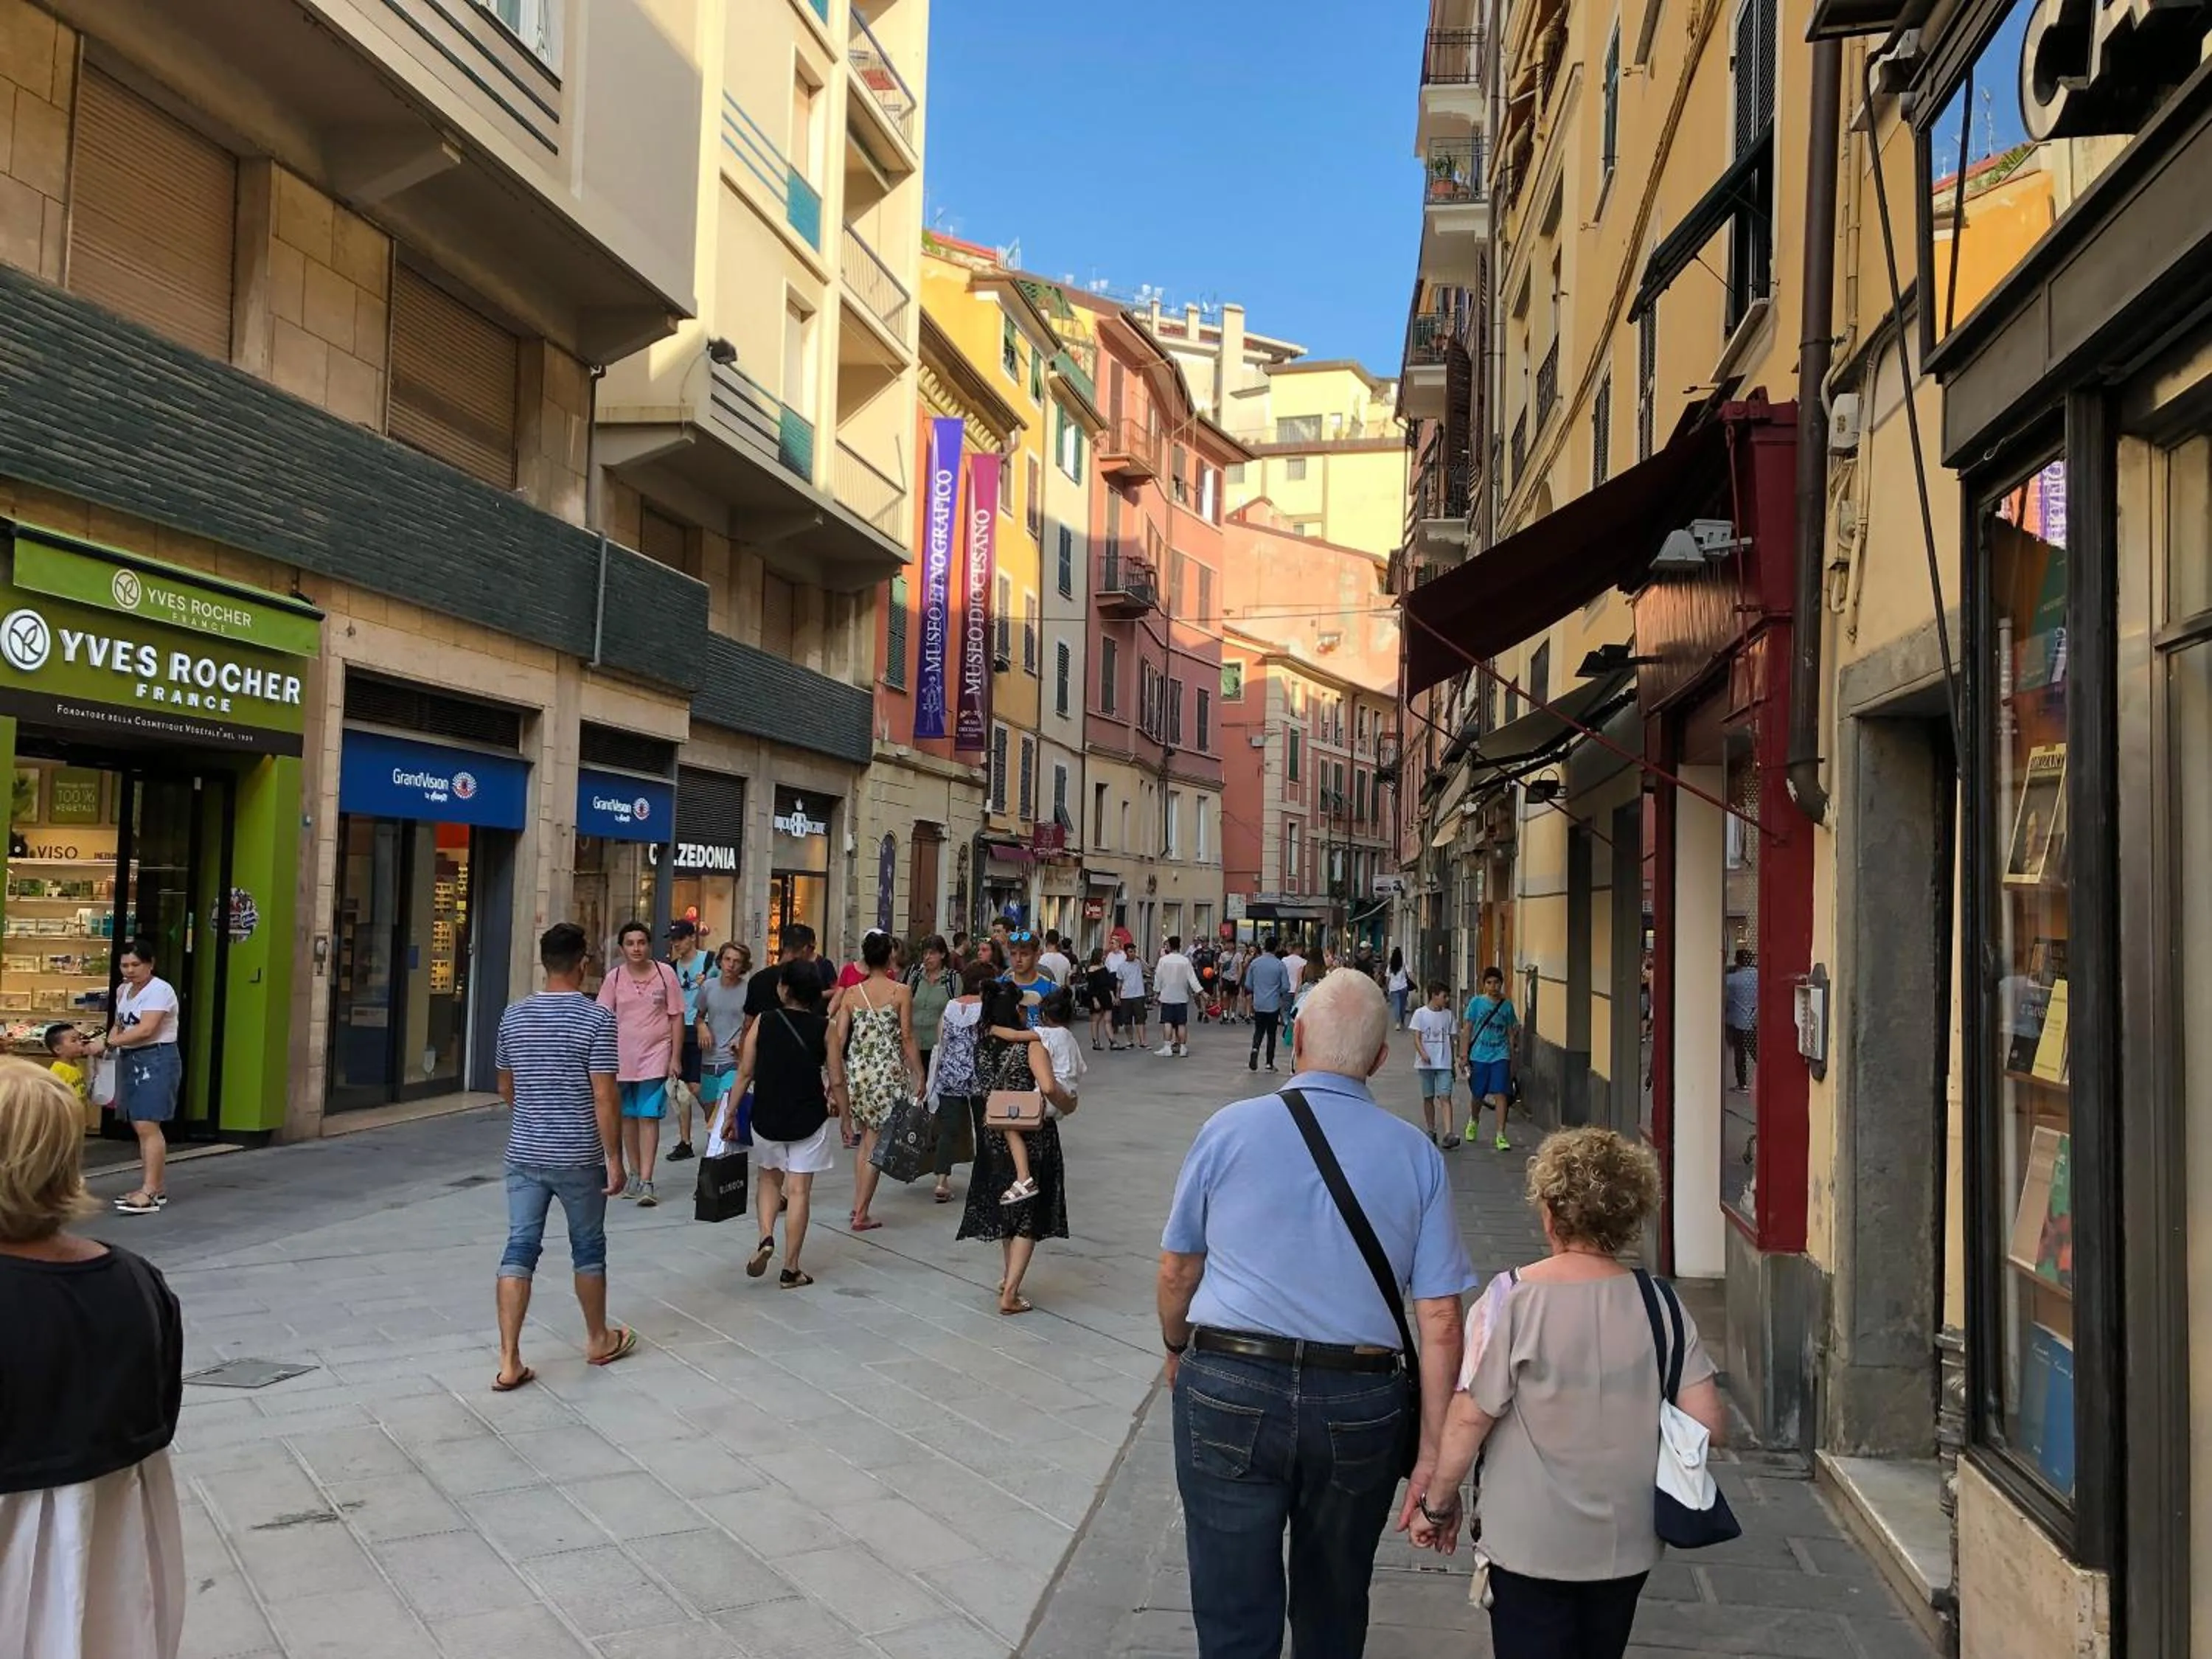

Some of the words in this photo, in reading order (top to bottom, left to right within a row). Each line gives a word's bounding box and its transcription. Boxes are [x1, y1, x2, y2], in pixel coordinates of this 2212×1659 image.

[928, 469, 953, 604] ETNOGRAFICO
[967, 509, 991, 625] DIOCESANO
[147, 587, 186, 613] YVES
[191, 599, 252, 628] ROCHER
[171, 613, 226, 633] FRANCE
[925, 606, 944, 673] MUSEO
[58, 629, 158, 678] YVES
[168, 651, 301, 705] ROCHER
[964, 626, 984, 696] MUSEO
[136, 684, 232, 713] FRANCE
[393, 768, 449, 790] GrandVision
[592, 796, 632, 813] GrandVision
[38, 846, 78, 859] VISO
[649, 843, 737, 869] CZEDONIA
